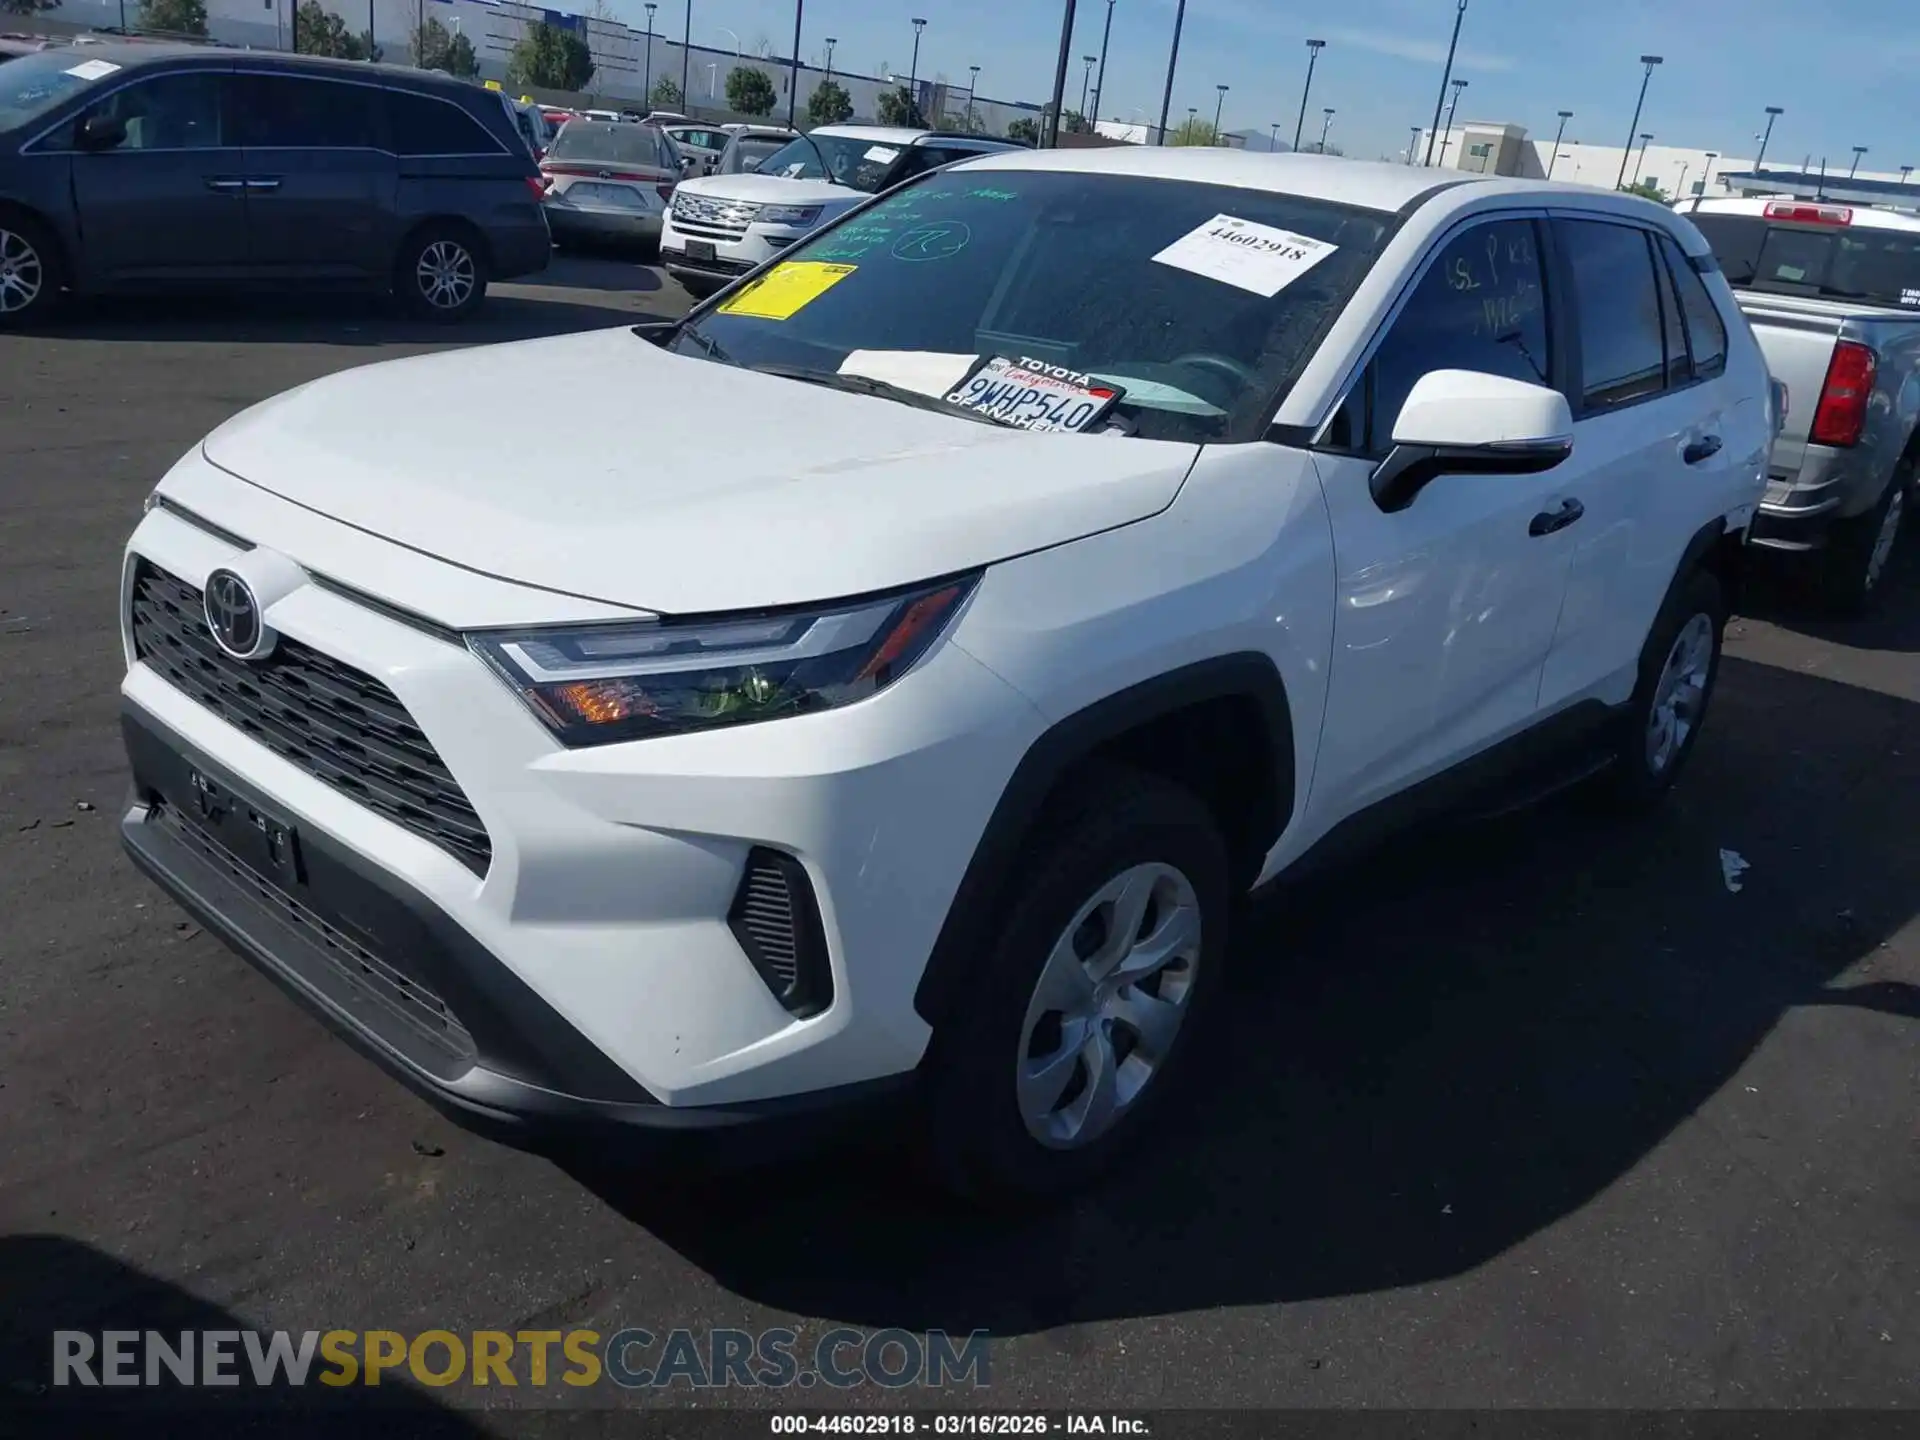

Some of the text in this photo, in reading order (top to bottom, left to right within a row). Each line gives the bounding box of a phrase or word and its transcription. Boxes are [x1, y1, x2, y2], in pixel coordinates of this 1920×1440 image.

[1208, 228, 1307, 260] 44602918
[1019, 356, 1090, 386] TOYOTA
[946, 393, 1068, 433] OF ANAHEI
[968, 378, 1094, 429] 9WHP540
